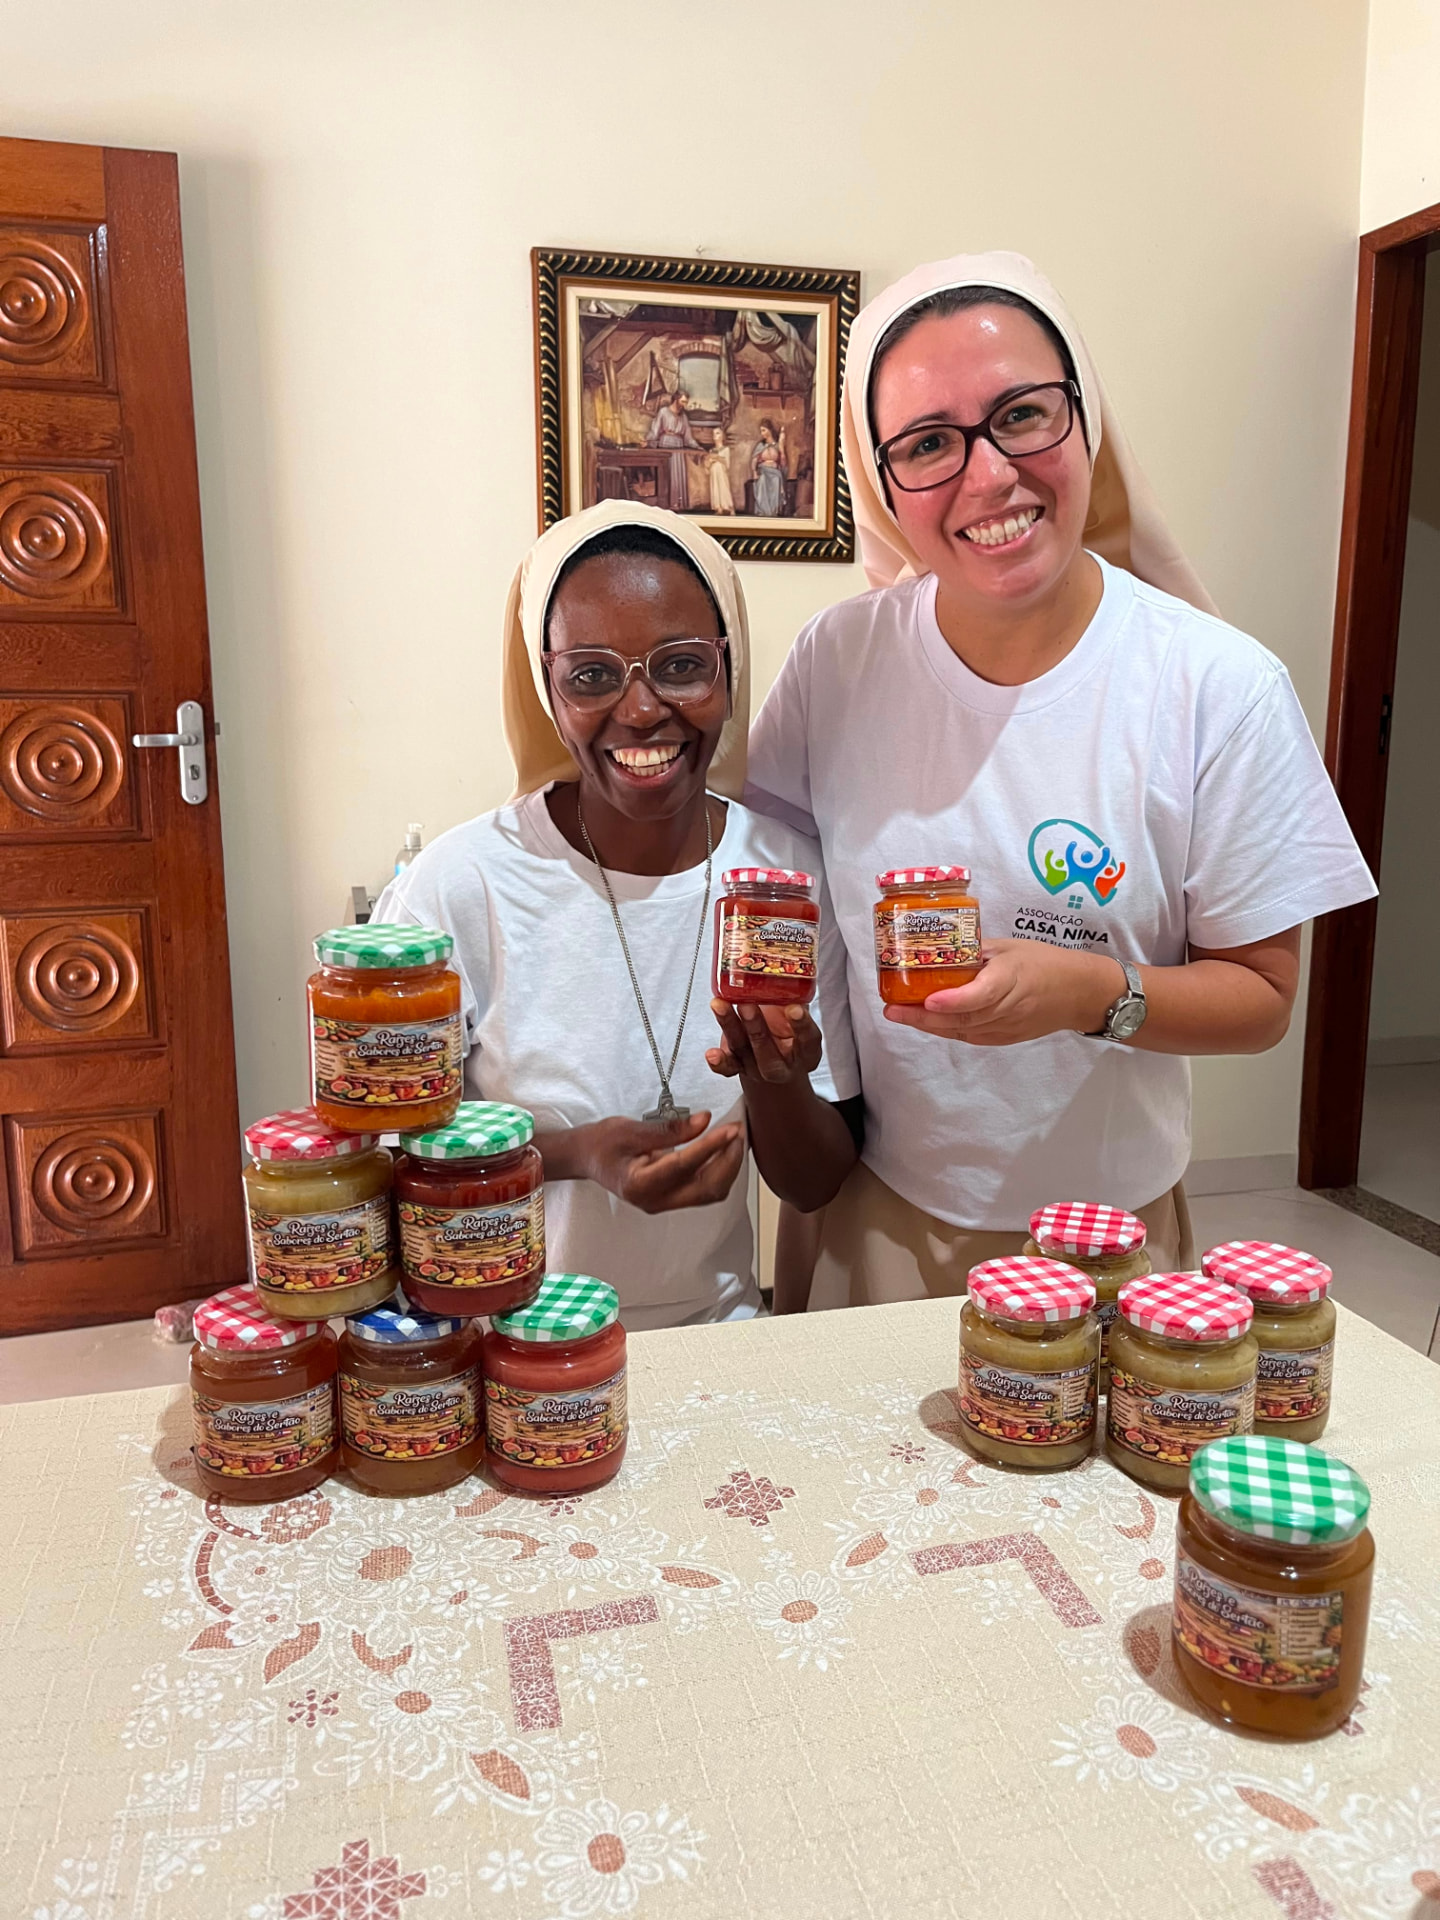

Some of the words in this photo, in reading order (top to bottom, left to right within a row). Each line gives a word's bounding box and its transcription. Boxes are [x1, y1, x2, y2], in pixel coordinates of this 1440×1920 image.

[1017, 907, 1083, 926] ASSOCIAÇÃO
[1015, 918, 1056, 937] CASA
[1062, 928, 1108, 943] NINA
